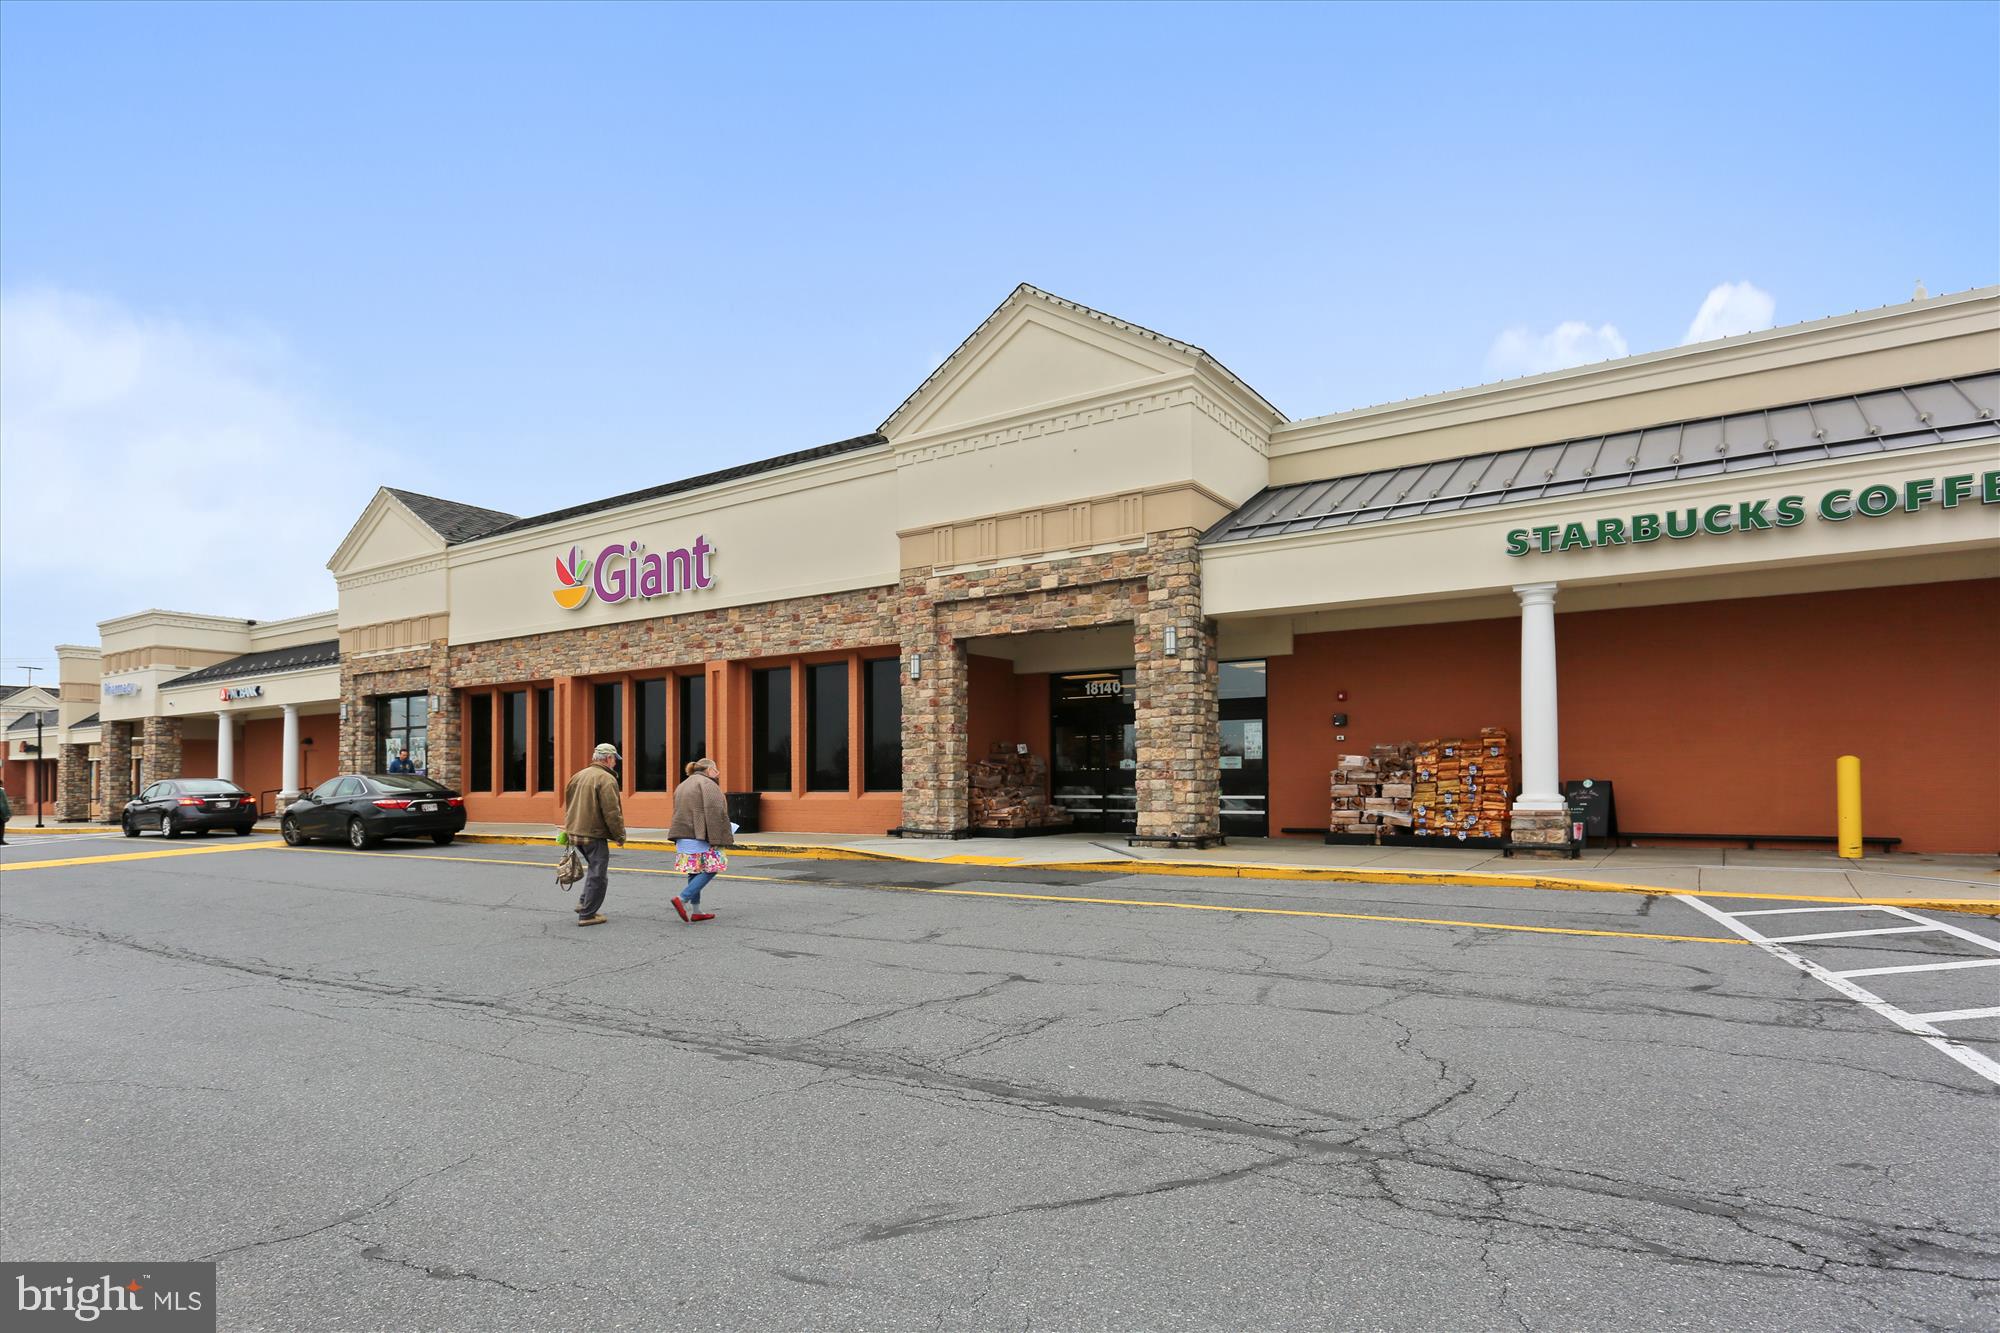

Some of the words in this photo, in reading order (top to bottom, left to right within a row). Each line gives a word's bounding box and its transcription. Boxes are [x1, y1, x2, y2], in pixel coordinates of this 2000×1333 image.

[1504, 495, 1806, 557] STARBUCKS
[593, 534, 713, 604] Giant
[1085, 681, 1120, 695] 18140
